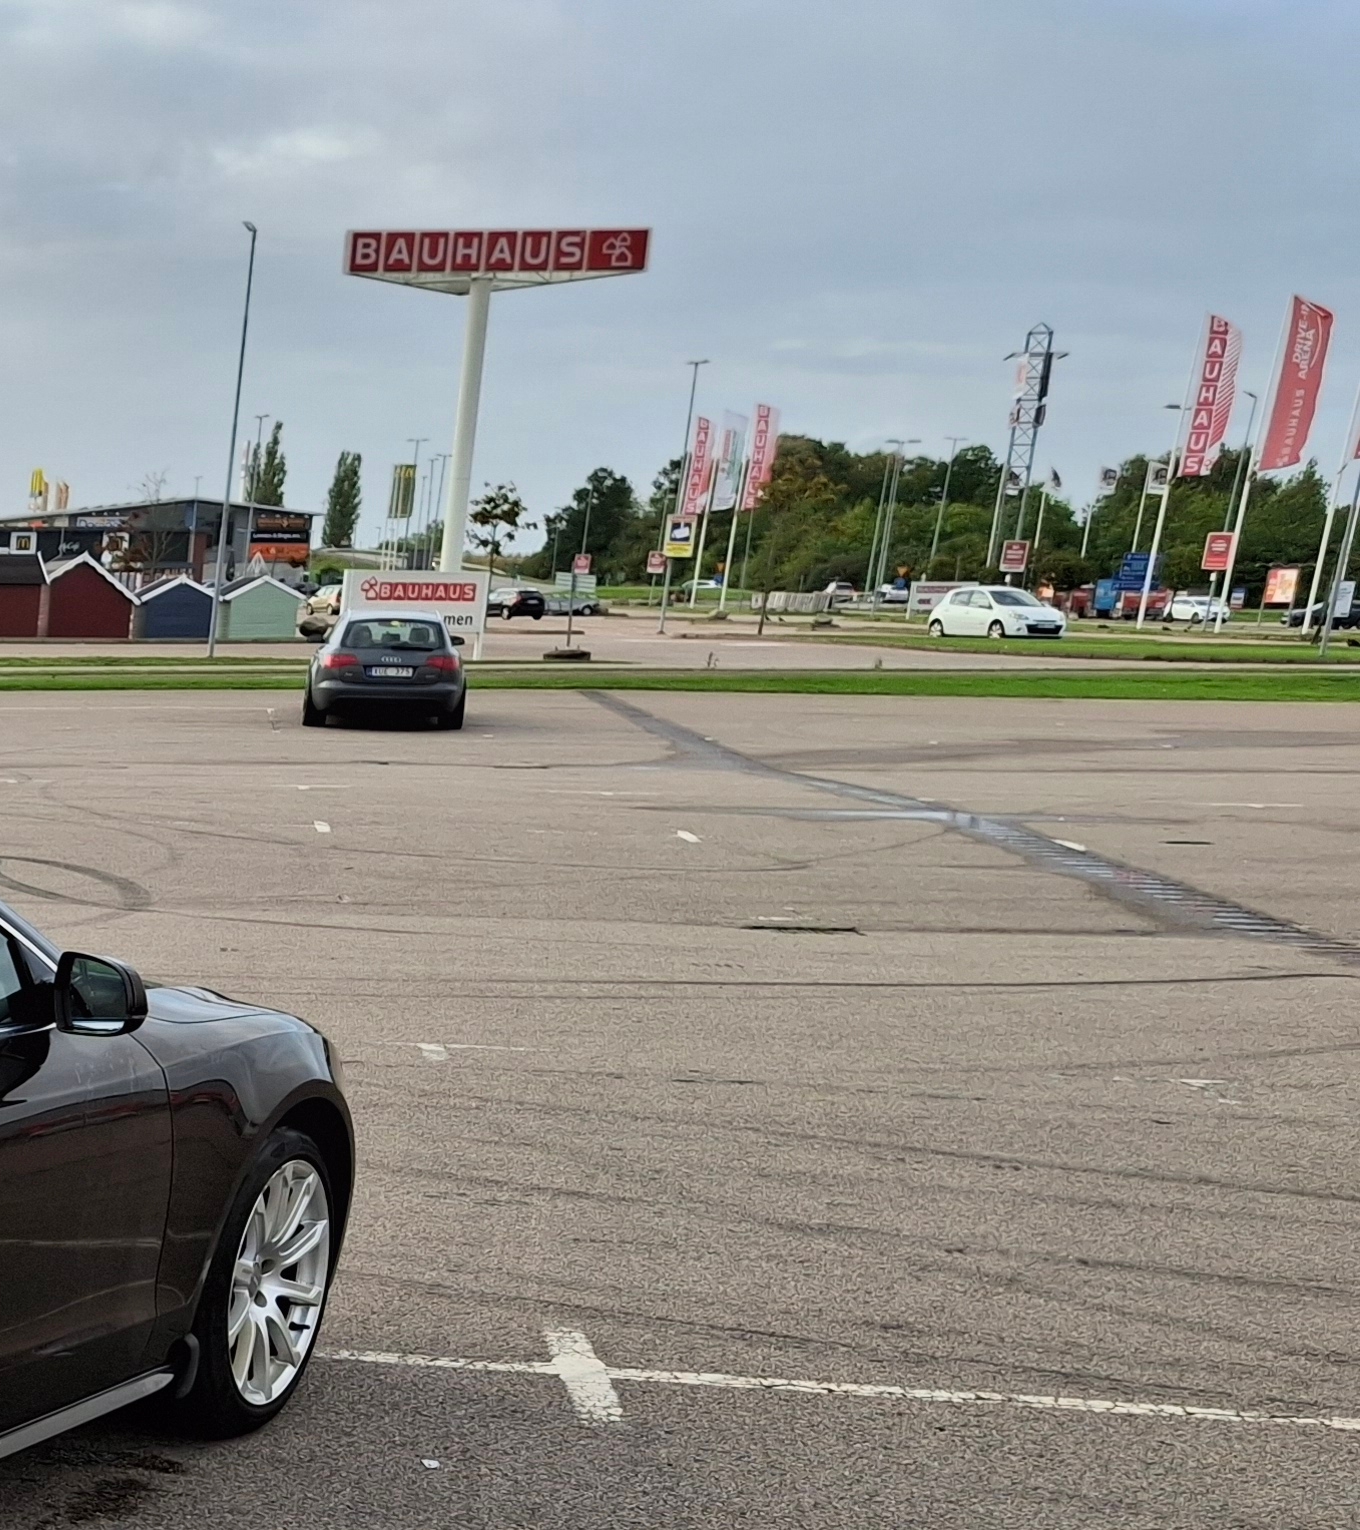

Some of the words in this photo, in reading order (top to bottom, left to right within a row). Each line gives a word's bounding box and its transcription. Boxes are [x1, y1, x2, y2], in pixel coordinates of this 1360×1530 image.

[354, 236, 582, 266] BAUHAUS
[1183, 316, 1227, 474] BAUHAUS
[685, 418, 709, 514] BAUHAUS
[380, 583, 475, 600] BAUHAUS
